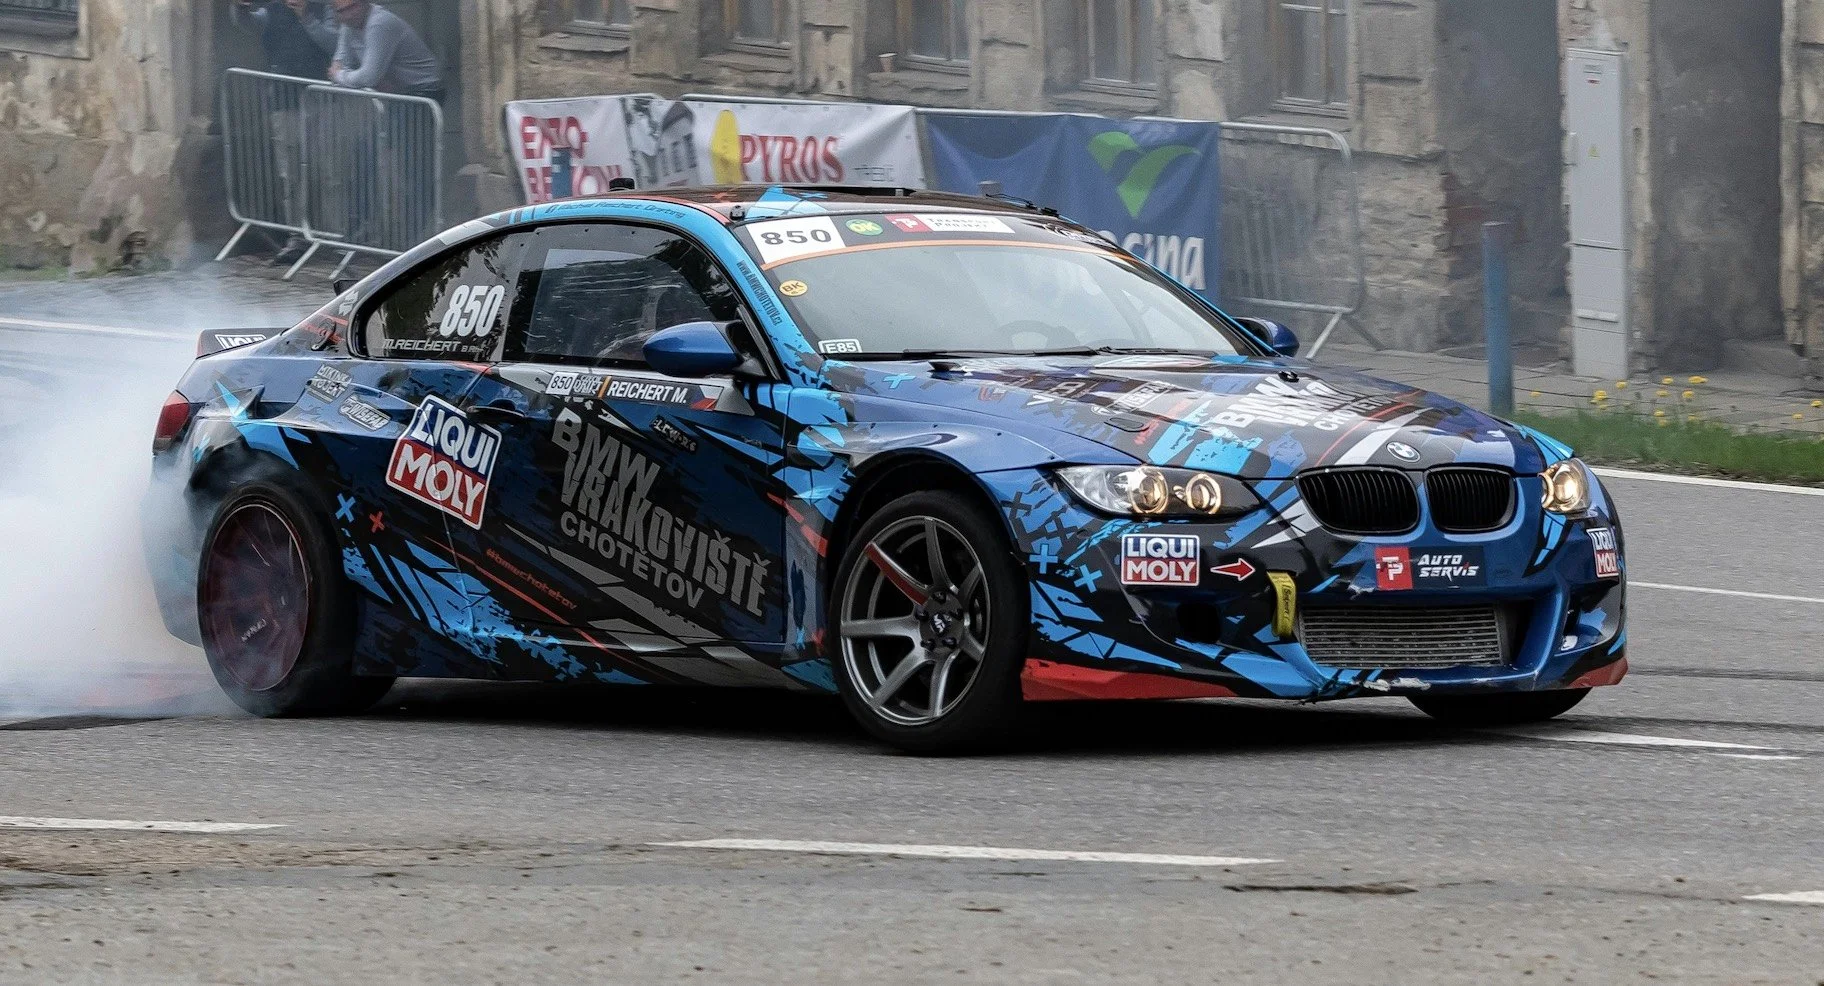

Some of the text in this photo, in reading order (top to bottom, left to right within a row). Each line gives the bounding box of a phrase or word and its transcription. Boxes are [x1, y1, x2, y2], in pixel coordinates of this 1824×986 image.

[739, 134, 845, 183] PYROS
[761, 229, 832, 245] 850
[440, 285, 505, 336] 850
[825, 342, 858, 353] E85
[551, 375, 574, 390] 850
[607, 381, 673, 401] REICHERT
[670, 387, 688, 403] M.
[410, 403, 495, 475] LIQUI
[551, 407, 661, 499] BMW
[394, 443, 486, 517] MOLY
[560, 453, 771, 617] VRAKOVIŠTĚ
[1127, 537, 1194, 558] LIQUI
[560, 511, 705, 609] CHOTĚTOV
[1126, 560, 1196, 582] MOLY
[1418, 554, 1463, 565] AUTO
